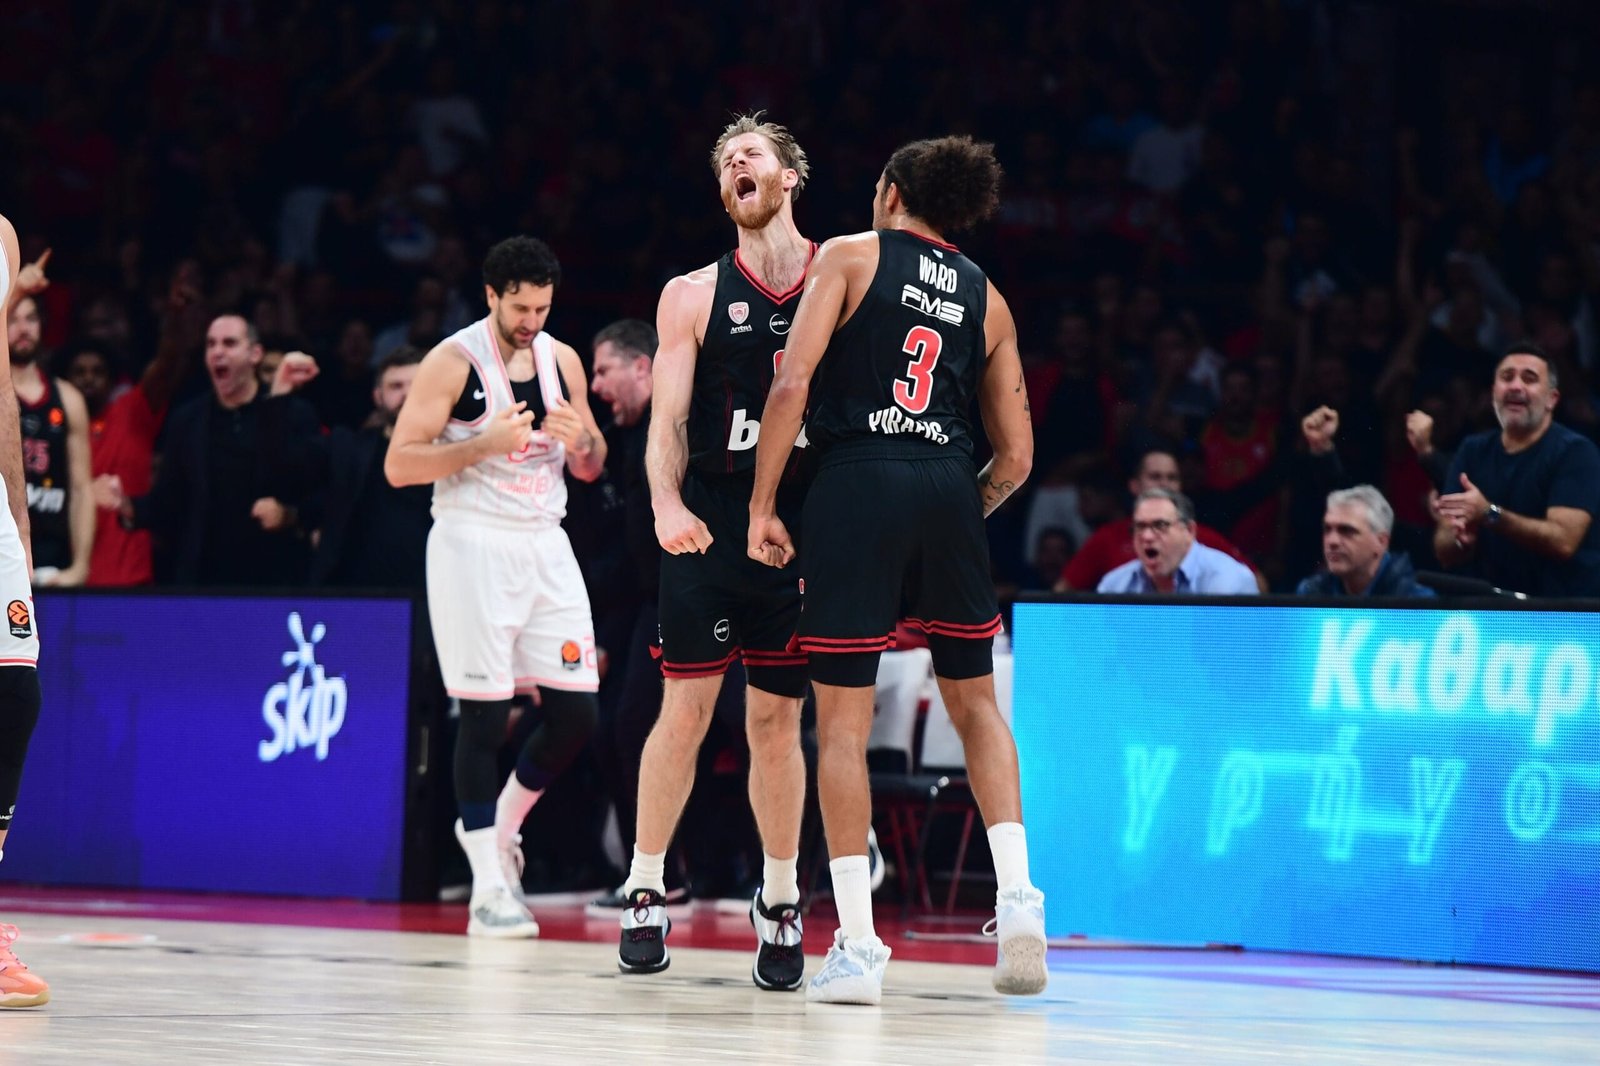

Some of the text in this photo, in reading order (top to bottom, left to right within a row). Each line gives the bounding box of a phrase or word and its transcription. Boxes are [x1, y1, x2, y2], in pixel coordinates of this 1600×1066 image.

[919, 254, 957, 294] WARD
[901, 284, 965, 327] FMS
[893, 325, 942, 414] 3
